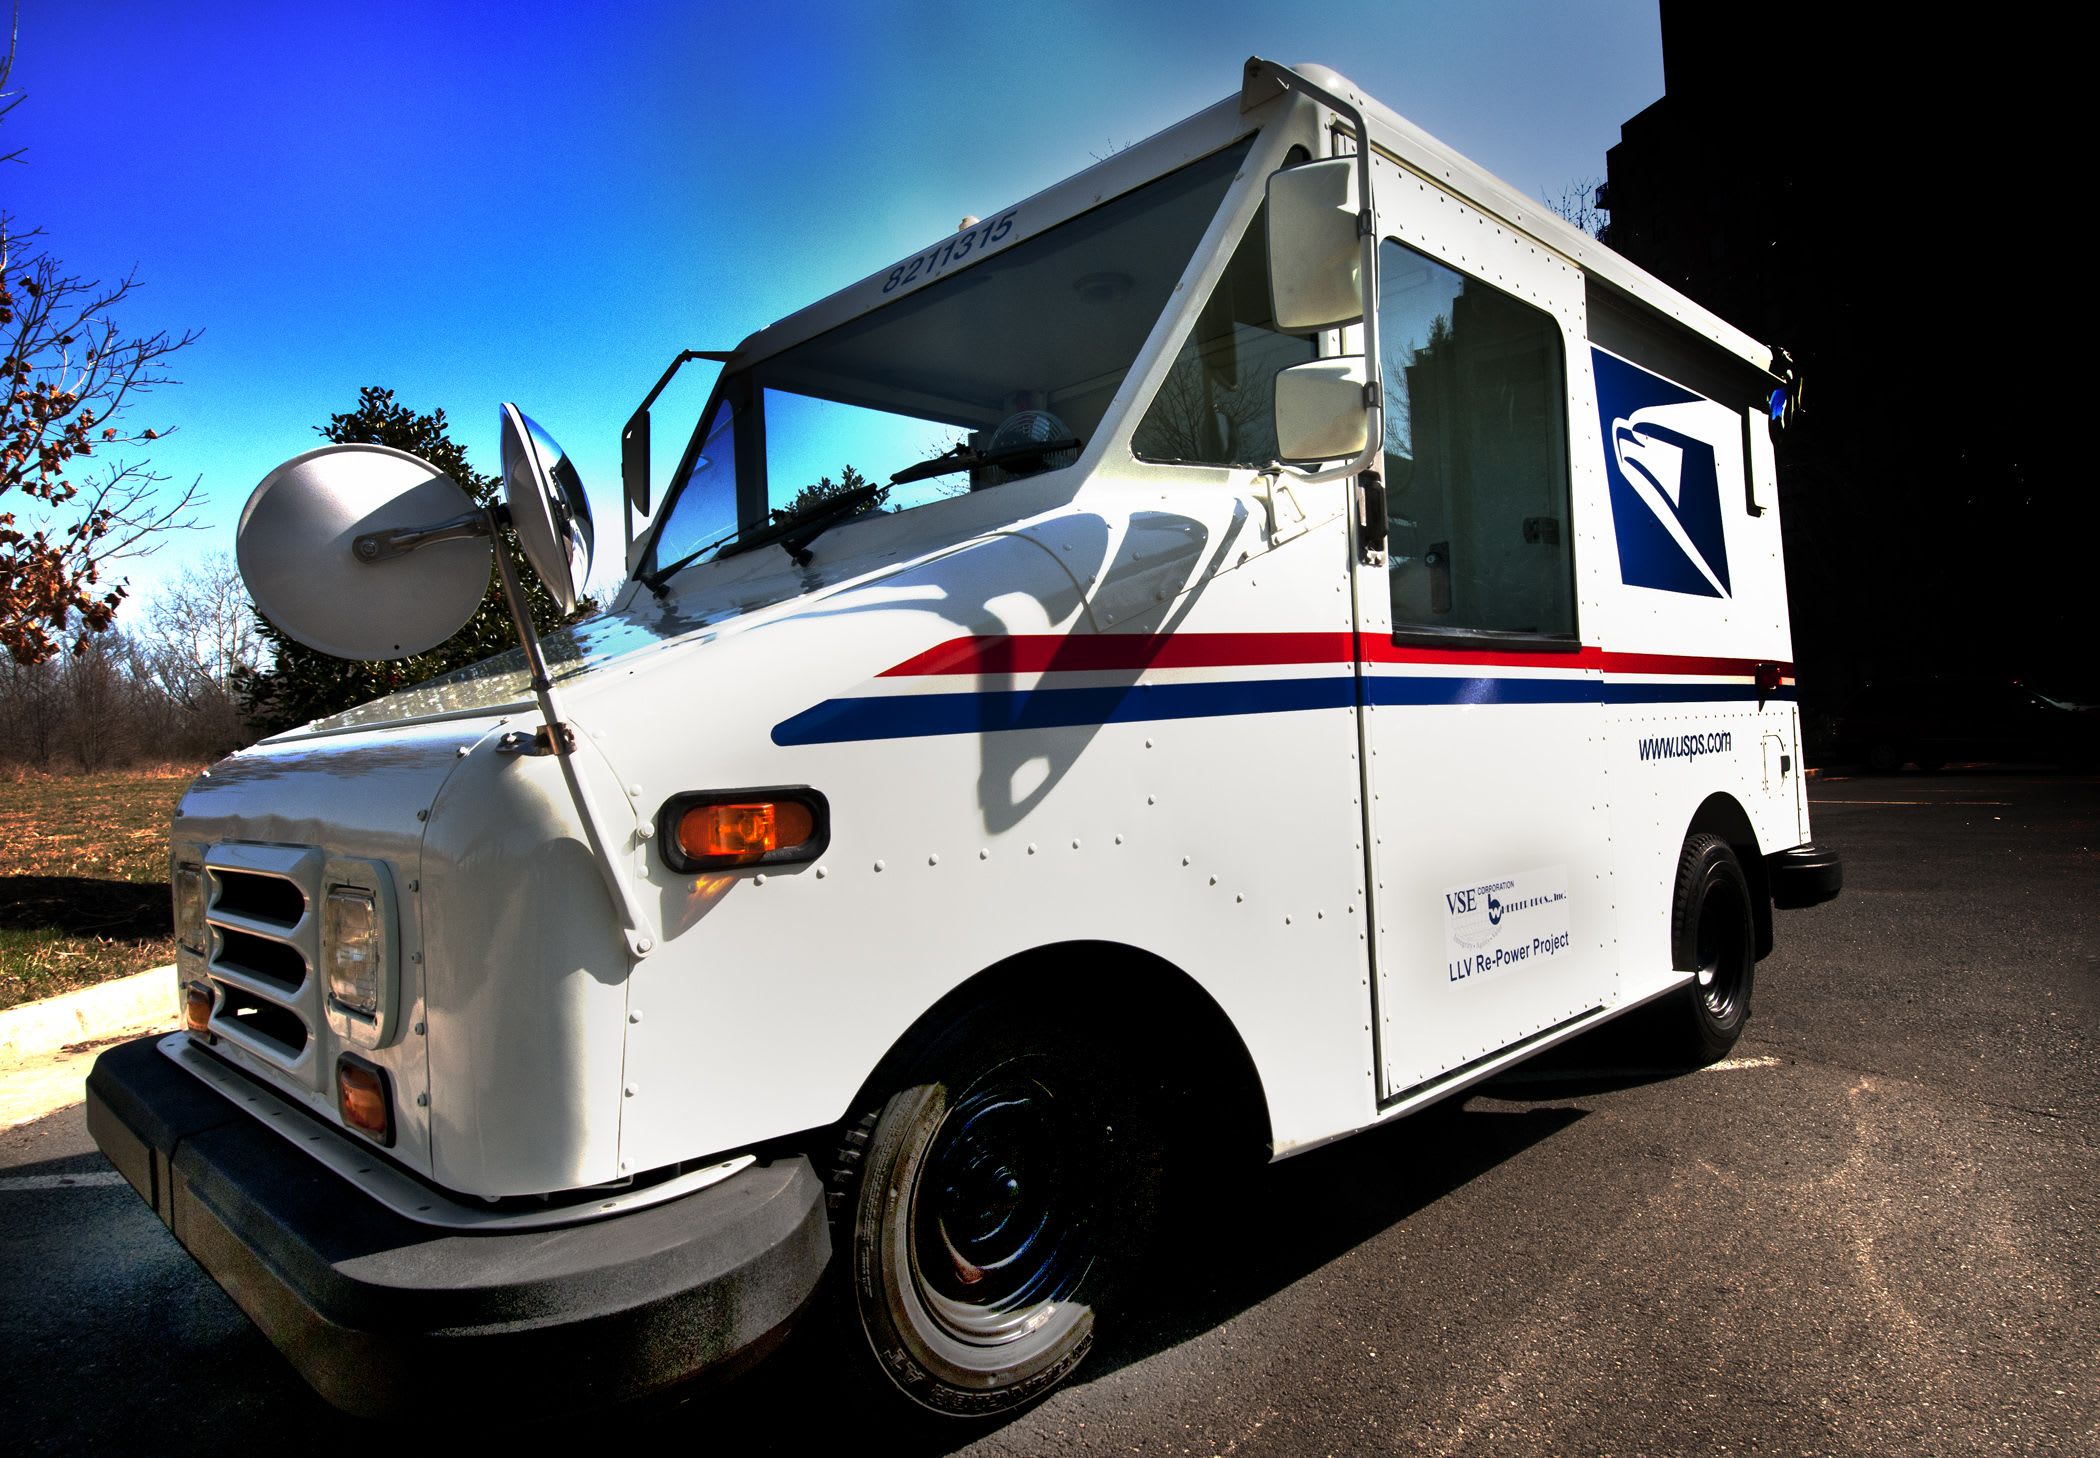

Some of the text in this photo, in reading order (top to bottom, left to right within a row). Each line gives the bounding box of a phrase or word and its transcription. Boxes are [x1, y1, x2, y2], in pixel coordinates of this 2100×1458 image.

[883, 210, 1017, 293] 8211315
[1639, 731, 1732, 763] www.usps.com
[1446, 888, 1477, 915] VSE
[1477, 881, 1514, 895] CORPORATION
[1449, 931, 1569, 982] LLV Re-Power Project
